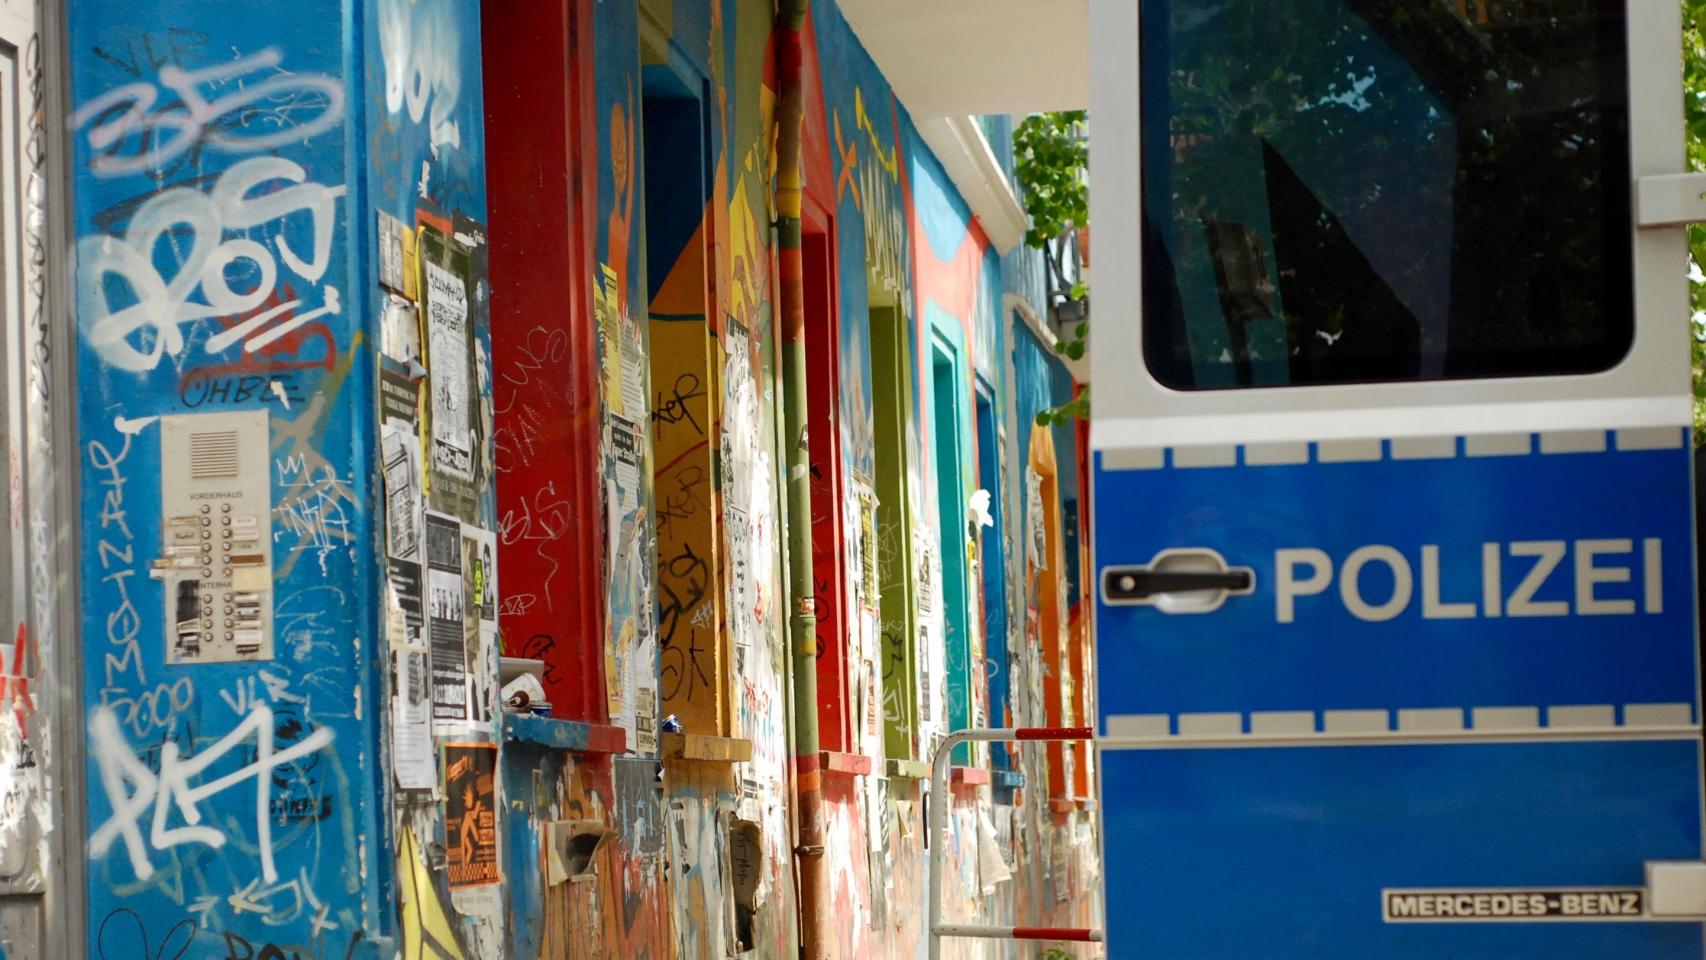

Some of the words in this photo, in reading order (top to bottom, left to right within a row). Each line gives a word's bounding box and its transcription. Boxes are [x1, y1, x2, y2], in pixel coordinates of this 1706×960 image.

[189, 491, 243, 501] VORDERHAUS
[1275, 538, 1663, 623] POLIZEI
[1391, 893, 1640, 917] MERCEDES-BENZ
